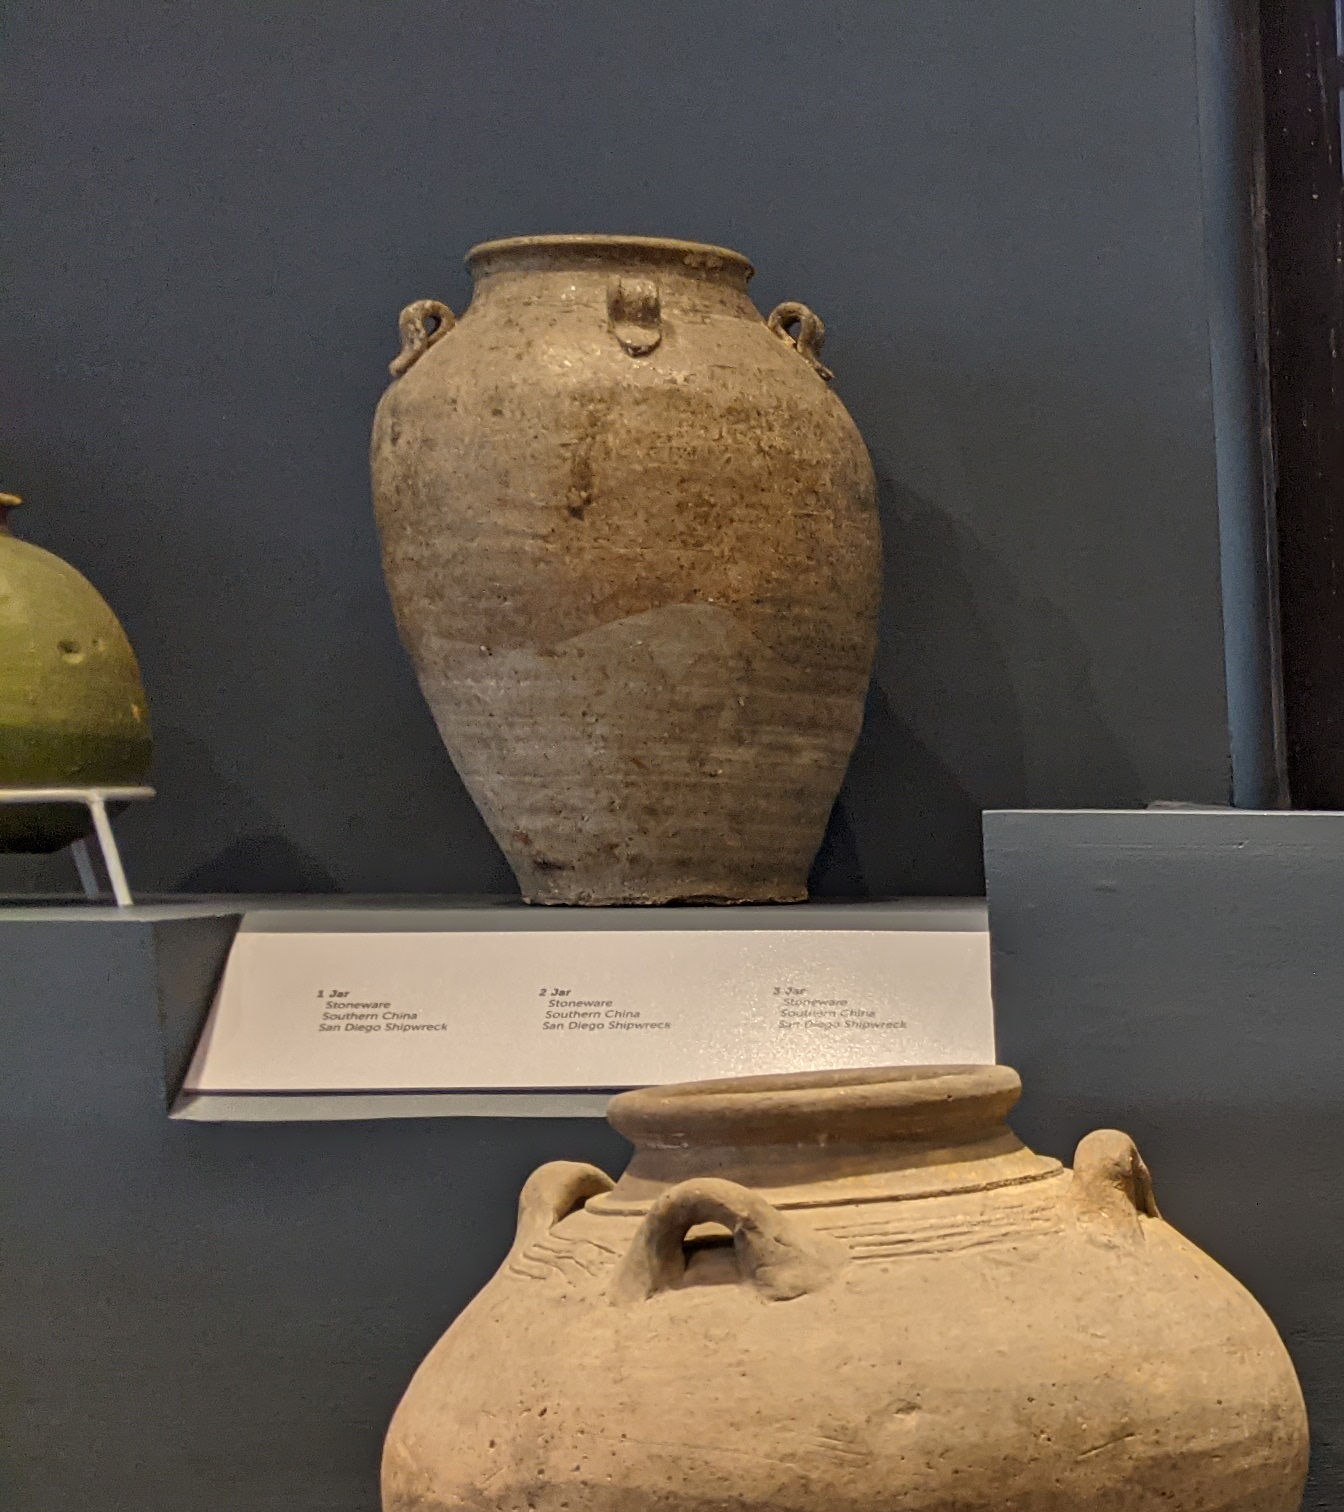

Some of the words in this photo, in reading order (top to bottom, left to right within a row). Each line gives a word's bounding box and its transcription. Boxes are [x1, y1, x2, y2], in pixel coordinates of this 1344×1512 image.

[317, 989, 324, 998] 1
[329, 989, 351, 998] Jar
[538, 988, 547, 997] 2
[550, 988, 572, 997] Jar
[784, 987, 806, 996] Jar
[325, 1000, 391, 1009] Stoneware
[548, 999, 613, 1008] Stoneware
[322, 1011, 378, 1021] Southern
[382, 1011, 418, 1020] China
[545, 1010, 601, 1019] Southern
[605, 1009, 641, 1019] China
[319, 1023, 341, 1032] San
[344, 1023, 381, 1034] Diego
[385, 1022, 448, 1033] Shipwreck
[542, 1021, 564, 1030] San
[568, 1021, 605, 1031] Diego
[608, 1021, 672, 1031] Shipwreck
[844, 1020, 907, 1030] Shipwreck
